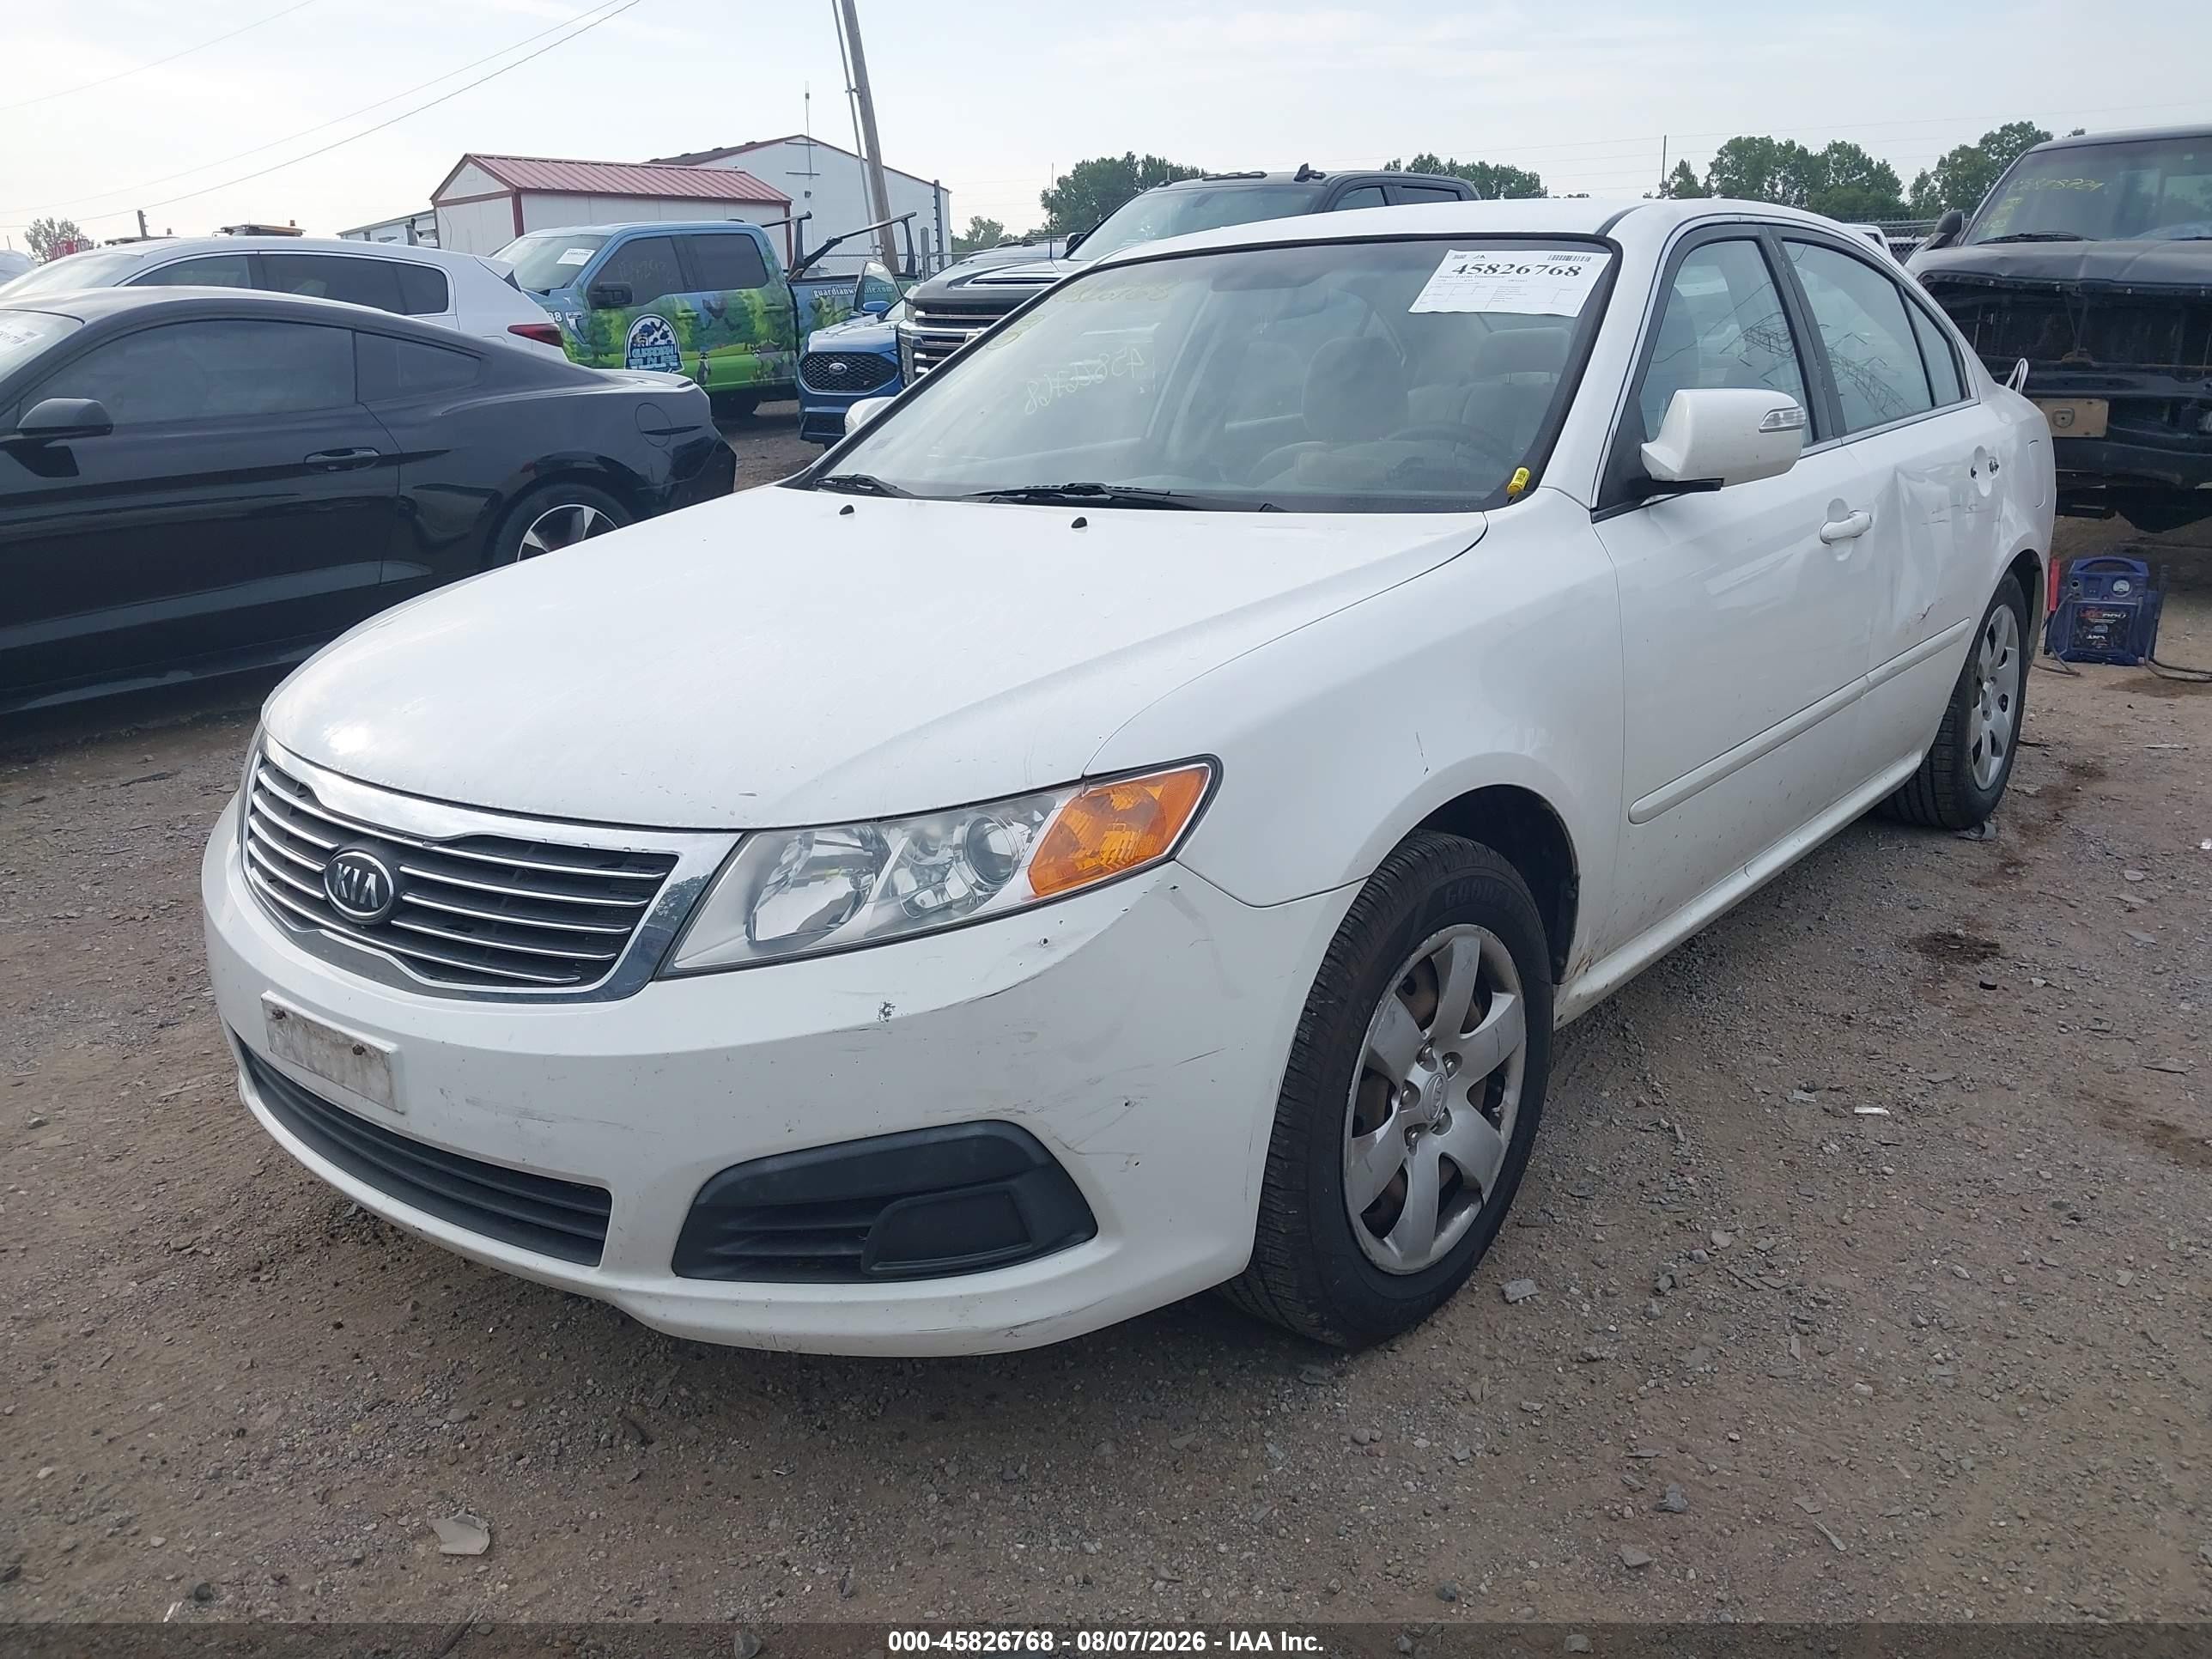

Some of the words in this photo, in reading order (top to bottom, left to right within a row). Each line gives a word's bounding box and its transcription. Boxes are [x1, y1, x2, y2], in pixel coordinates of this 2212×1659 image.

[1452, 263, 1582, 276] 45826768
[813, 284, 893, 298] guardianwilife.com
[334, 862, 379, 908] KIA
